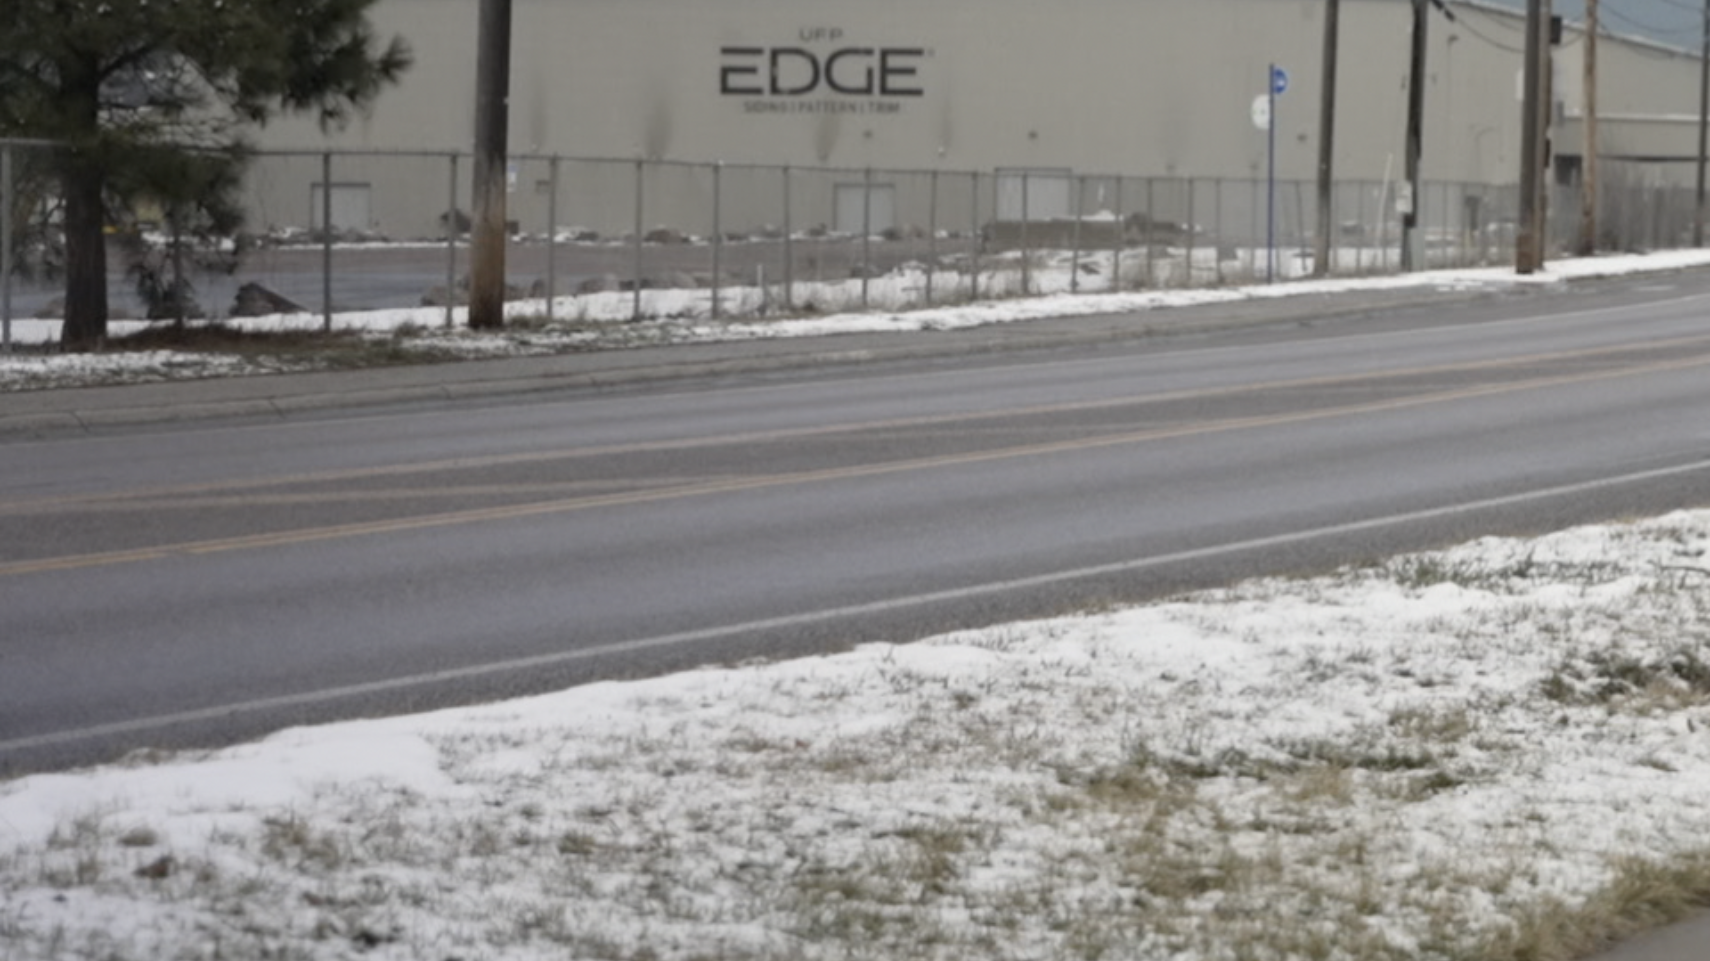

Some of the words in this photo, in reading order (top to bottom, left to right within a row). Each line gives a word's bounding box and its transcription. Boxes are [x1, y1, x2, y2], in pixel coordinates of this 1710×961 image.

[799, 27, 843, 42] UFP
[720, 47, 924, 96] EDGE
[799, 100, 859, 114] PATTERN
